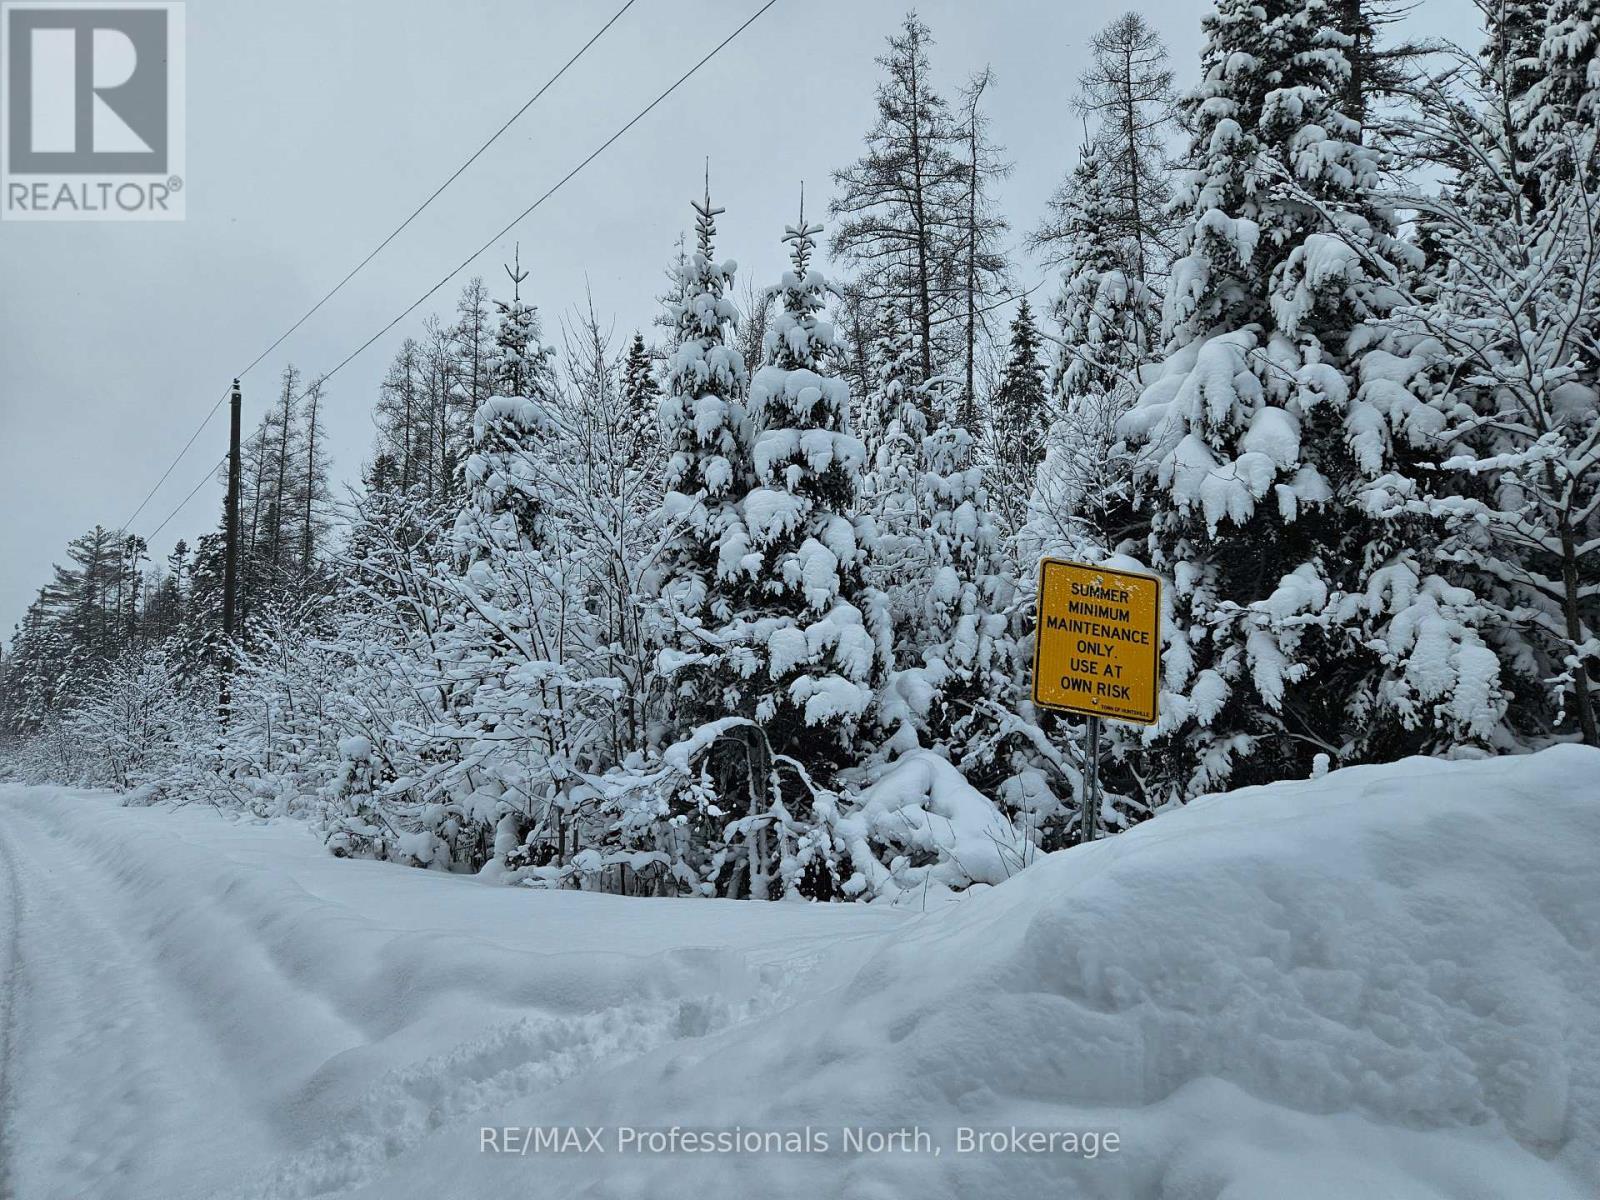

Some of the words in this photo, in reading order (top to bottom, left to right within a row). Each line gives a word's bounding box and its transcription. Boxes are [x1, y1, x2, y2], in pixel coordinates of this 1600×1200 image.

[1071, 582, 1129, 604] SUMMER
[1068, 601, 1130, 623] MINIMUM
[1047, 616, 1149, 645] MAINTENANCE
[1070, 658, 1098, 675] USE
[1103, 664, 1123, 679] AT
[1061, 676, 1092, 693] OWN
[1097, 682, 1130, 700] RISK
